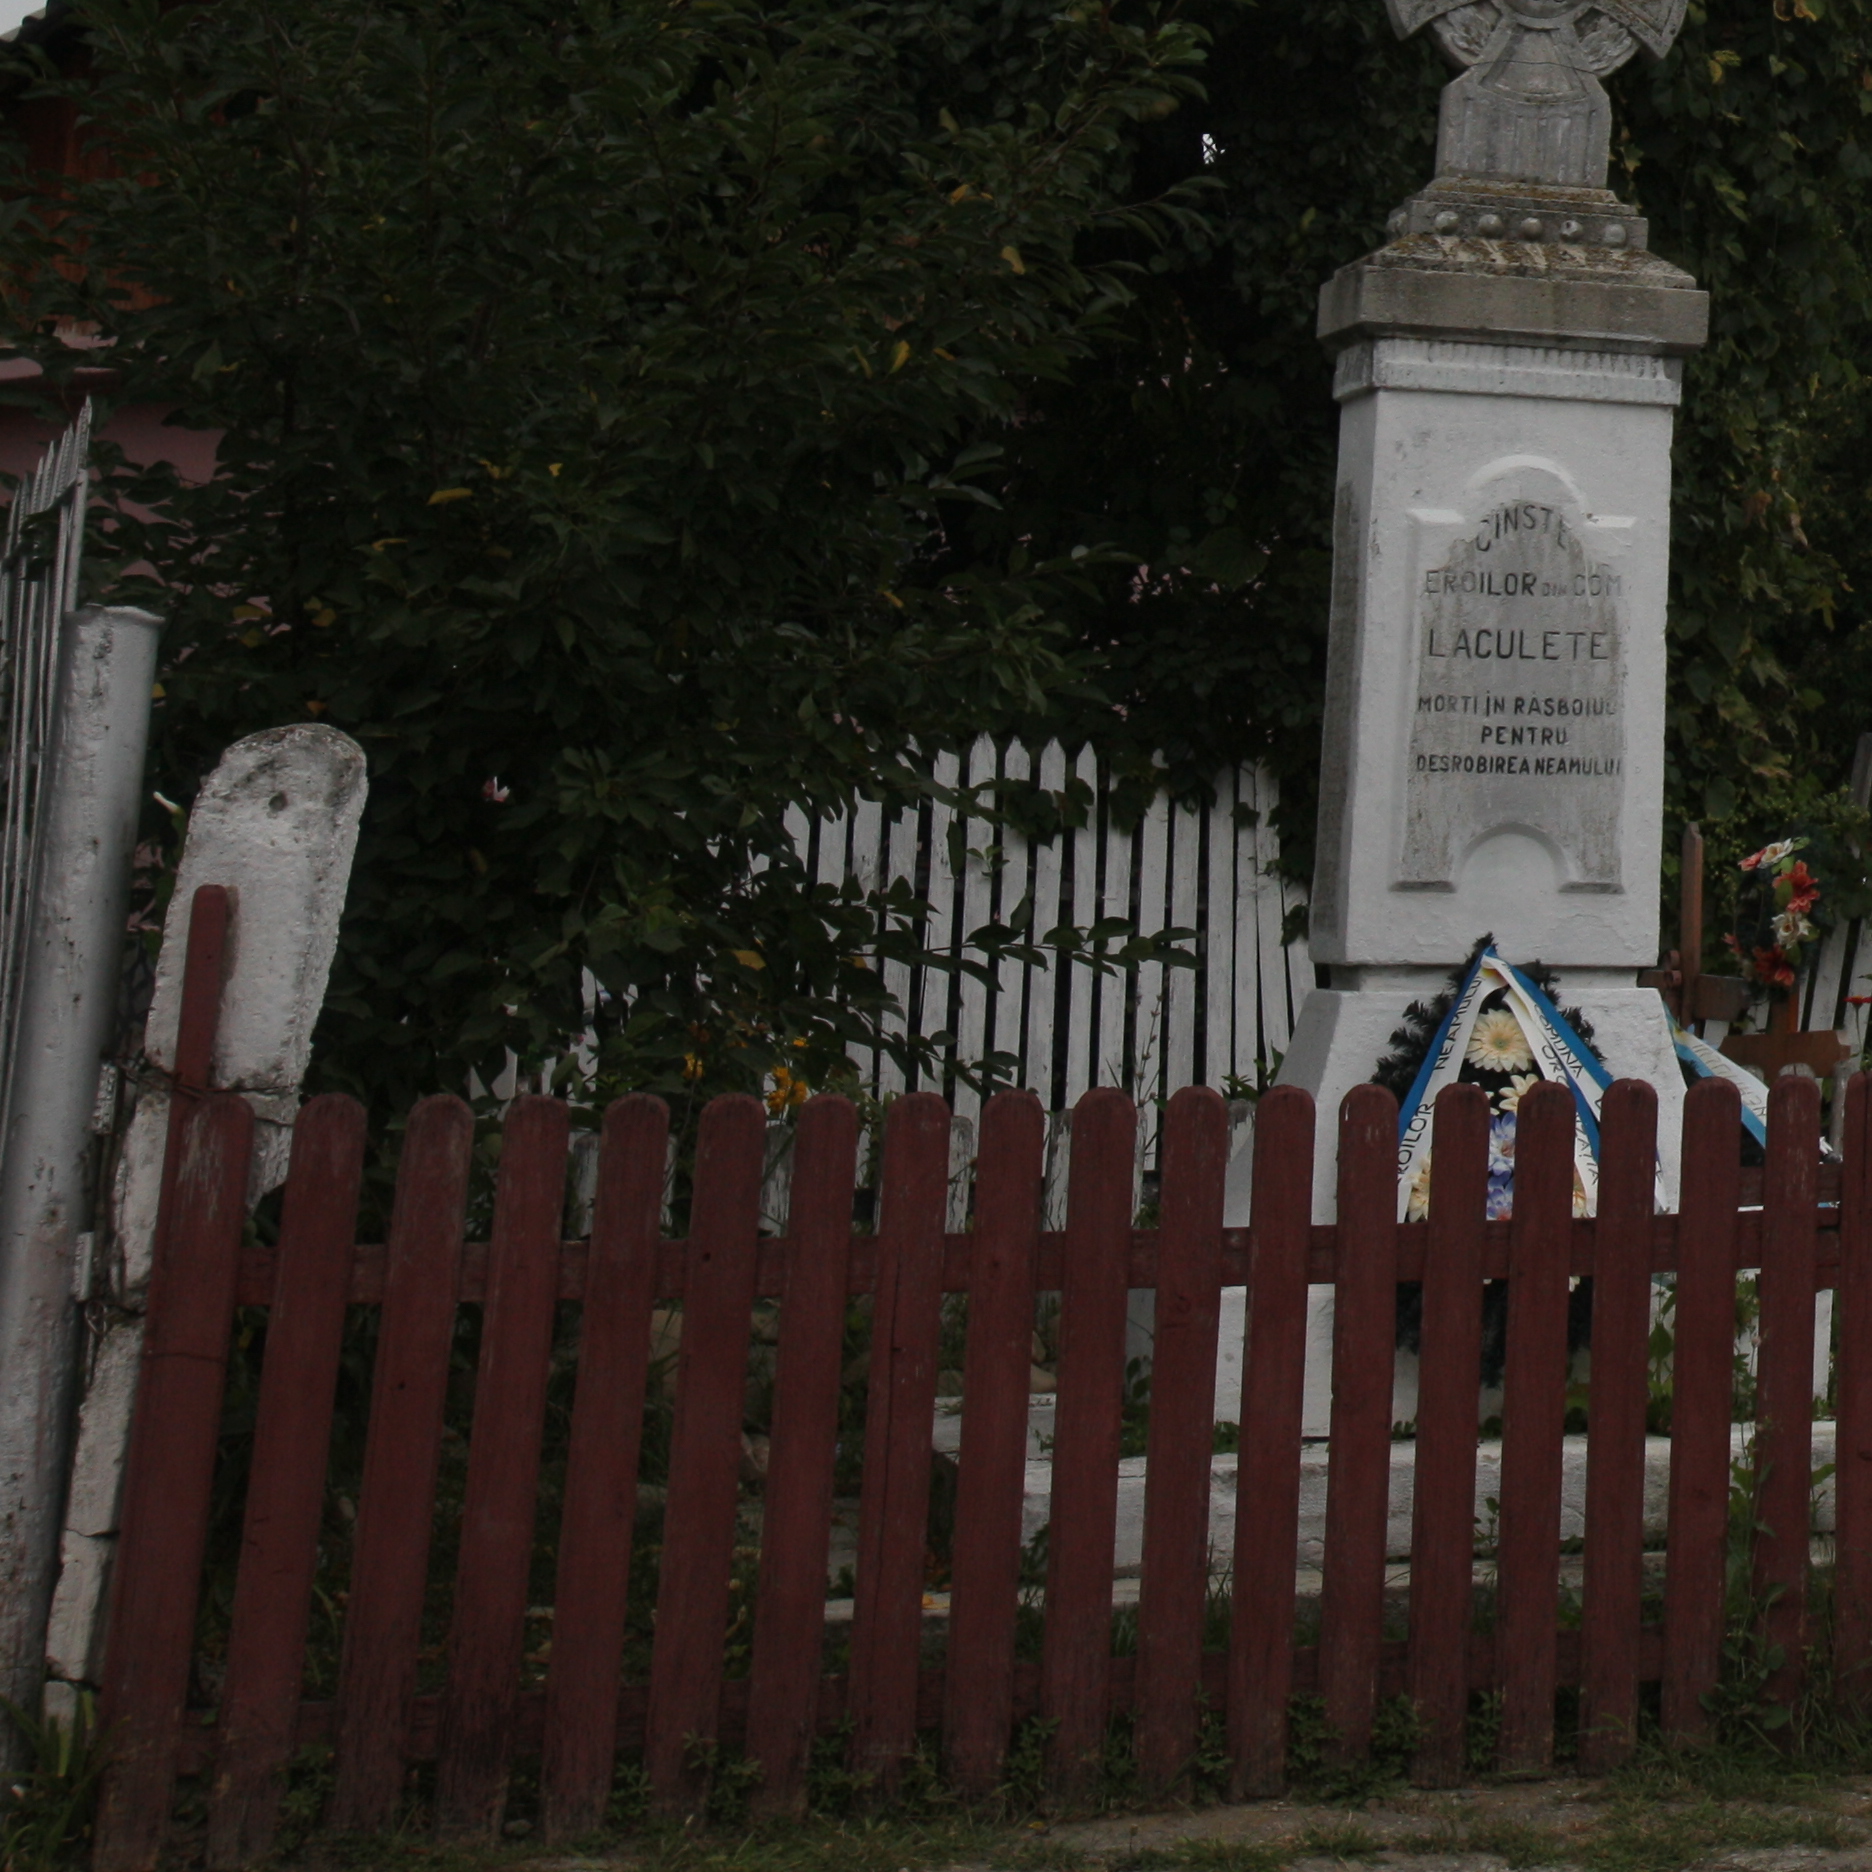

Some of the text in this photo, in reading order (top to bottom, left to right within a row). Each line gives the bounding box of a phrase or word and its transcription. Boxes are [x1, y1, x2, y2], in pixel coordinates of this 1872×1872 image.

[1426, 570, 1538, 597] EROILOR
[1428, 628, 1609, 661] LACULETE
[1481, 726, 1567, 746] PENTRU
[1416, 754, 1621, 777] DESROBIREA NEAMULUI
